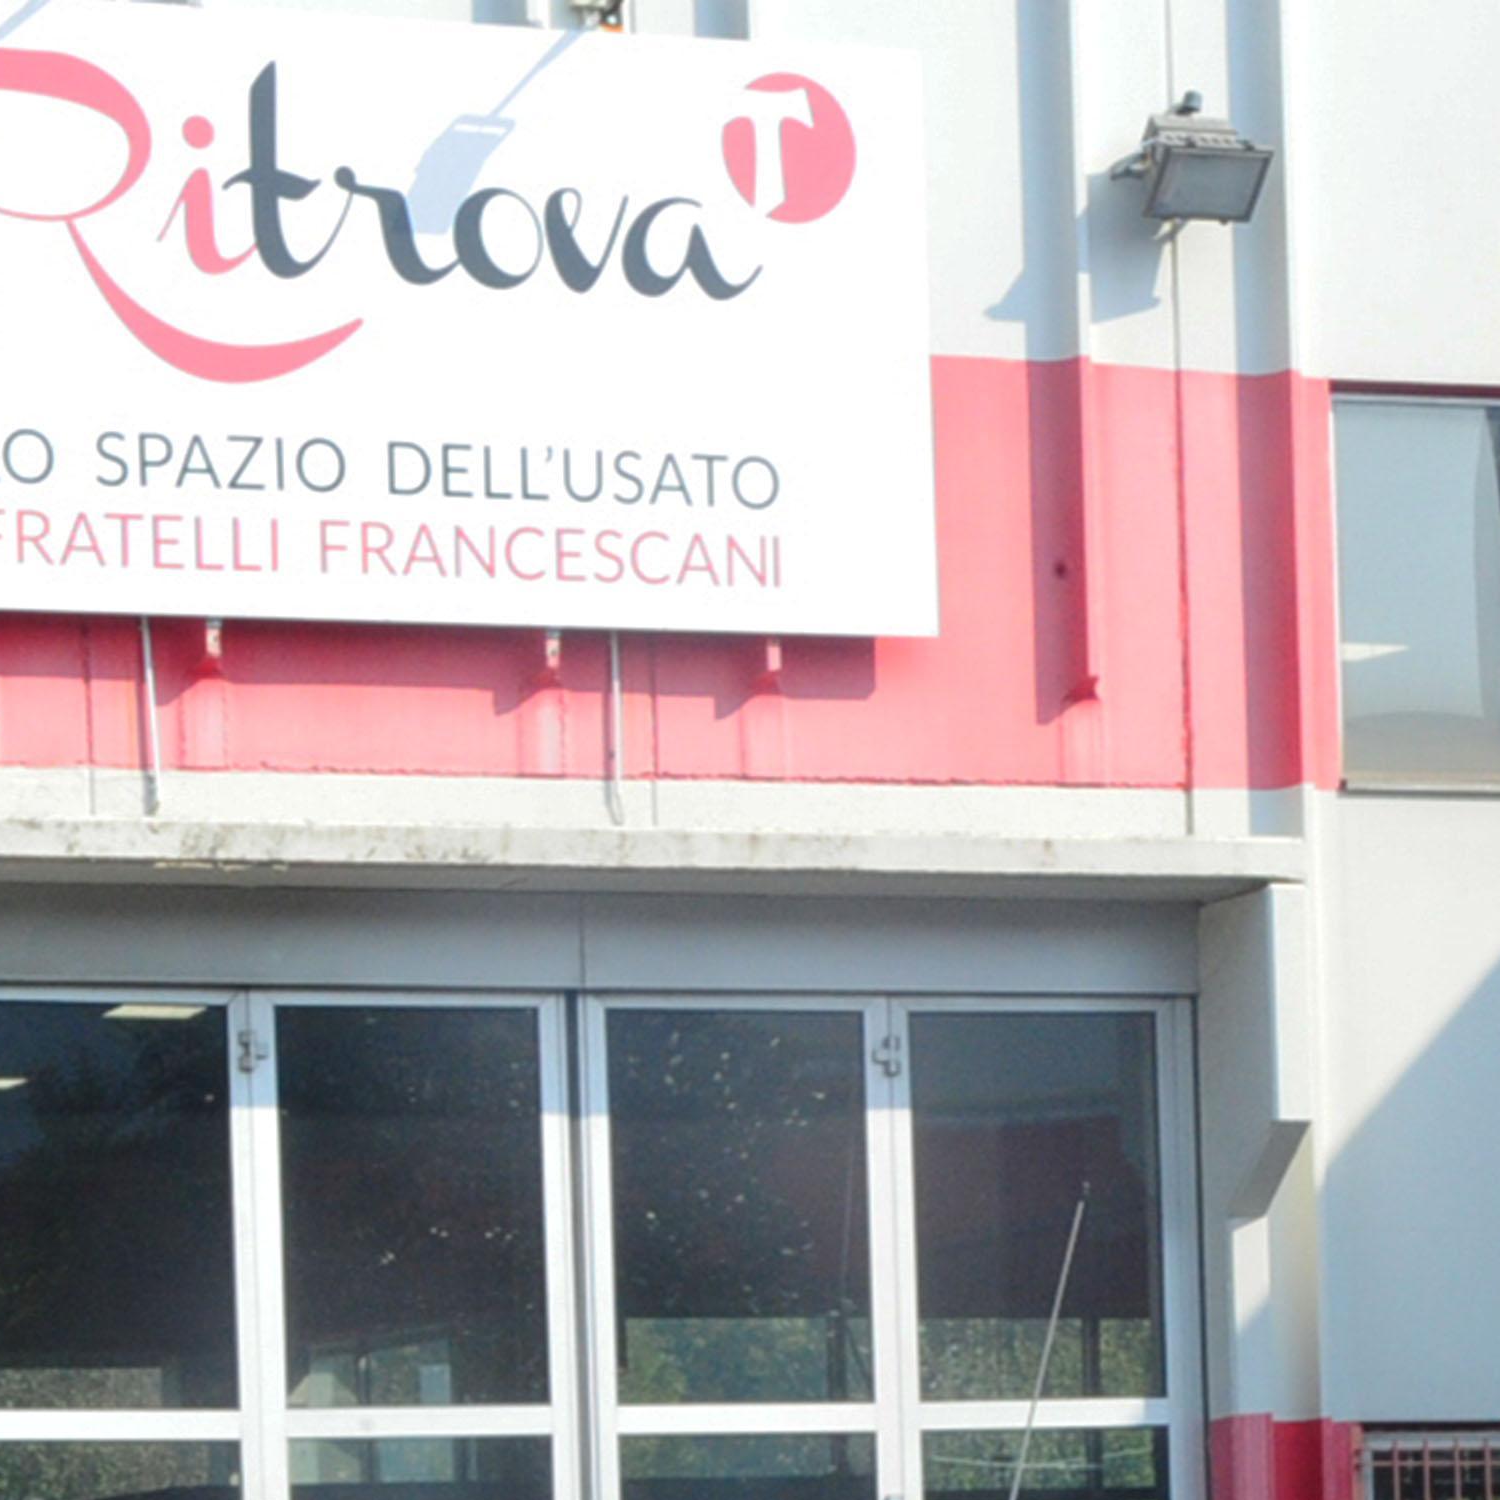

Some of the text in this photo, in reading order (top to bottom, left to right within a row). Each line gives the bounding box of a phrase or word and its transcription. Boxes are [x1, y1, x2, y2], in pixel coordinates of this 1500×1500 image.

[95, 429, 347, 495] SPAZIO
[386, 437, 782, 510] DELL'USATO
[317, 518, 784, 588] FRANCESCANI
